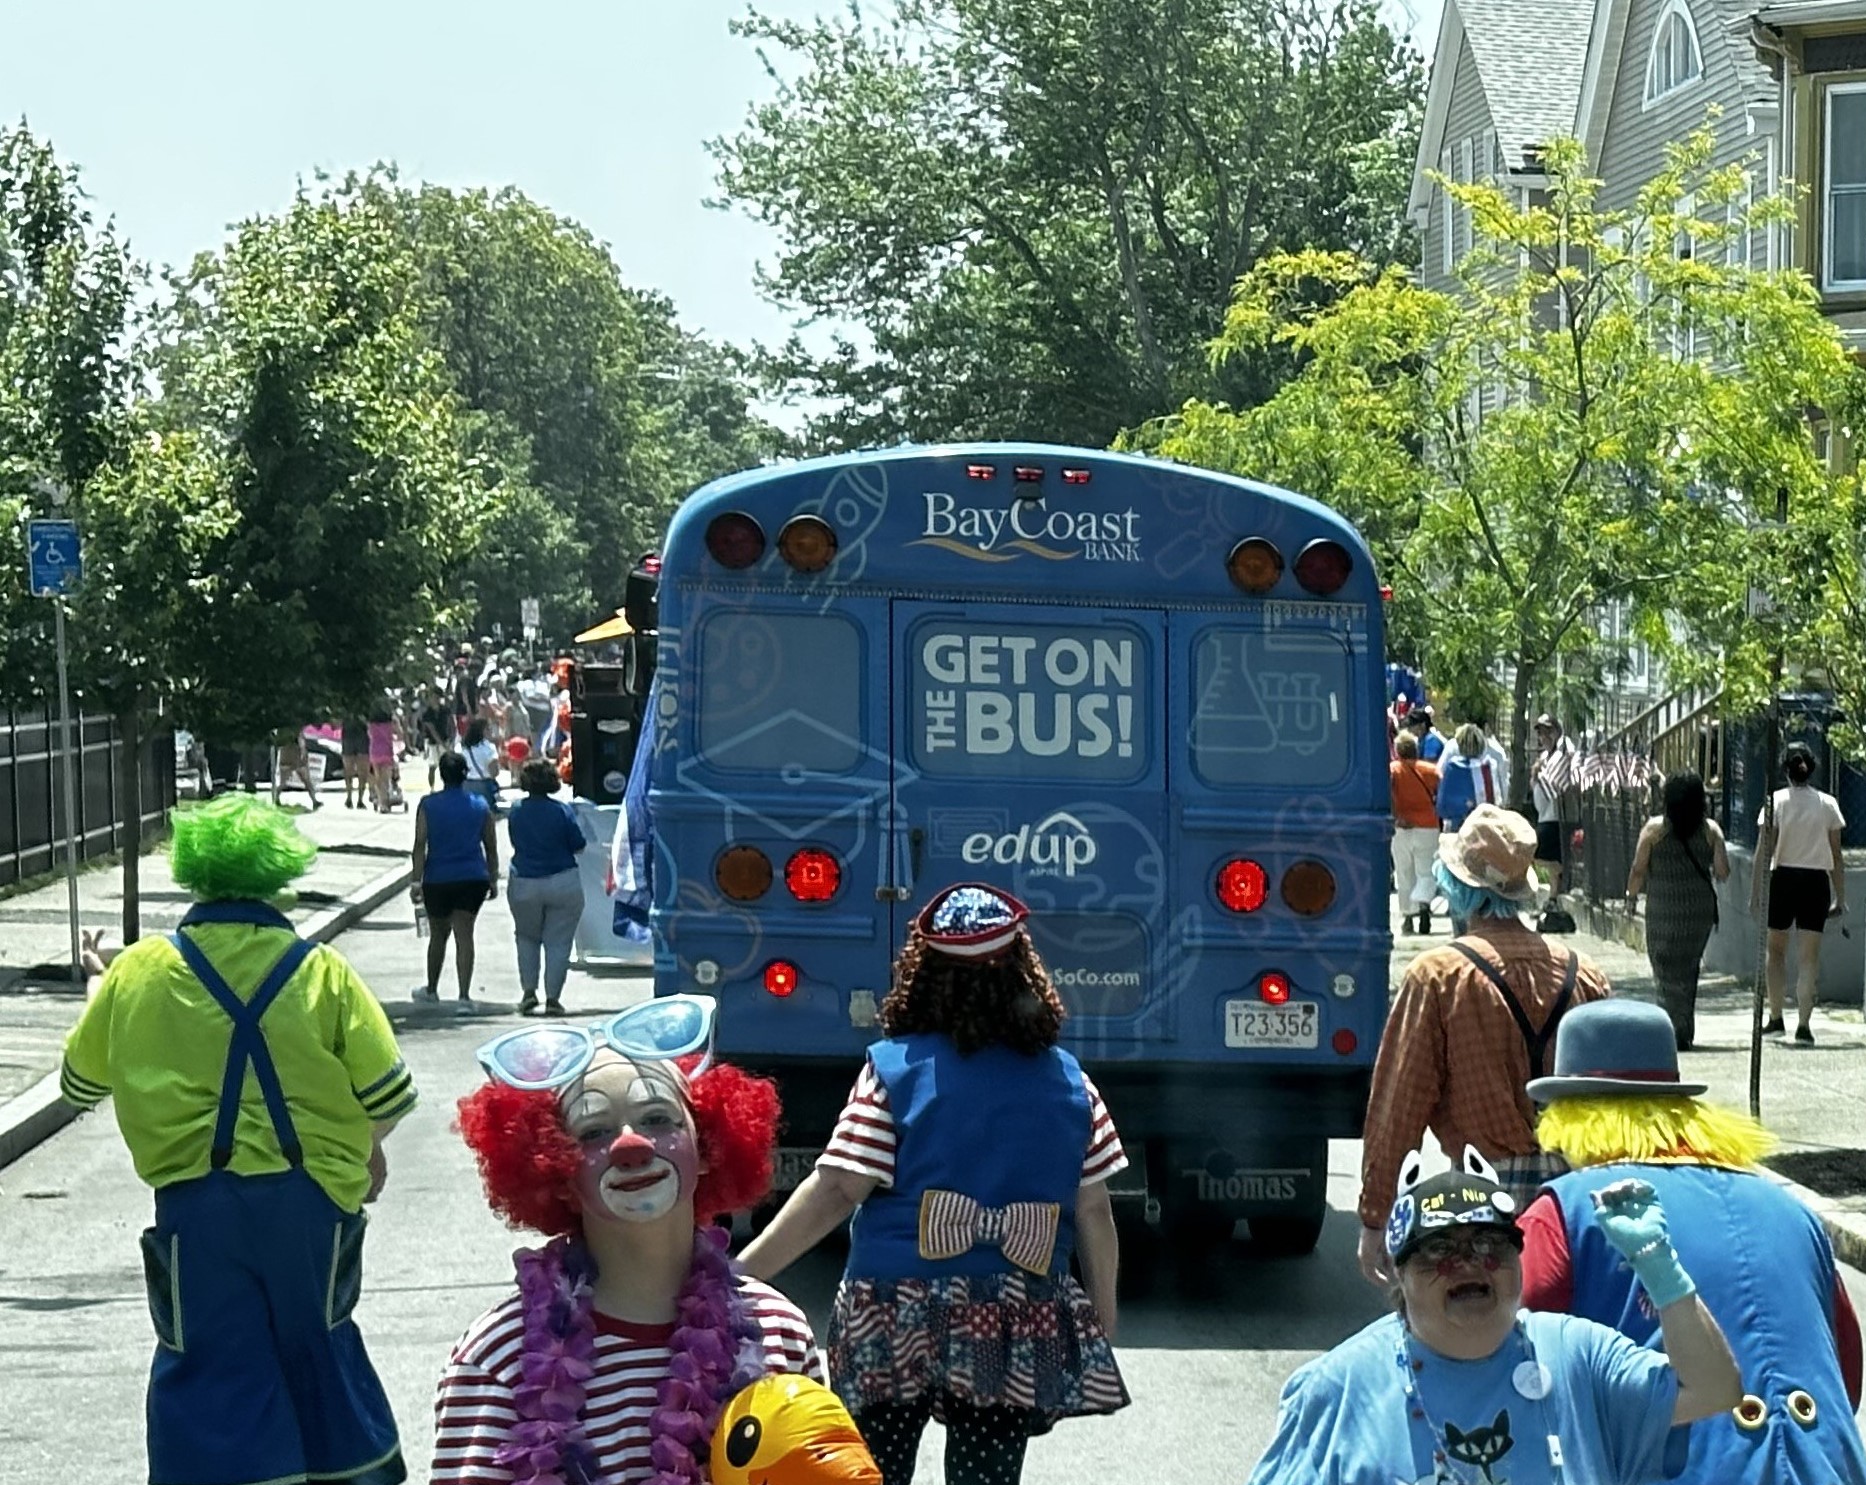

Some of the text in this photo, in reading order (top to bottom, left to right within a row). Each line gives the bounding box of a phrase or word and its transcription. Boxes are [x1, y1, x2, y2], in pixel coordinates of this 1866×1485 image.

[922, 492, 1141, 550] BayCoast
[1083, 542, 1141, 561] BANK
[922, 634, 1132, 687] GET ON
[925, 689, 956, 753] THE
[965, 691, 1132, 757] BUS!
[1190, 1168, 1304, 1200] Thomas
